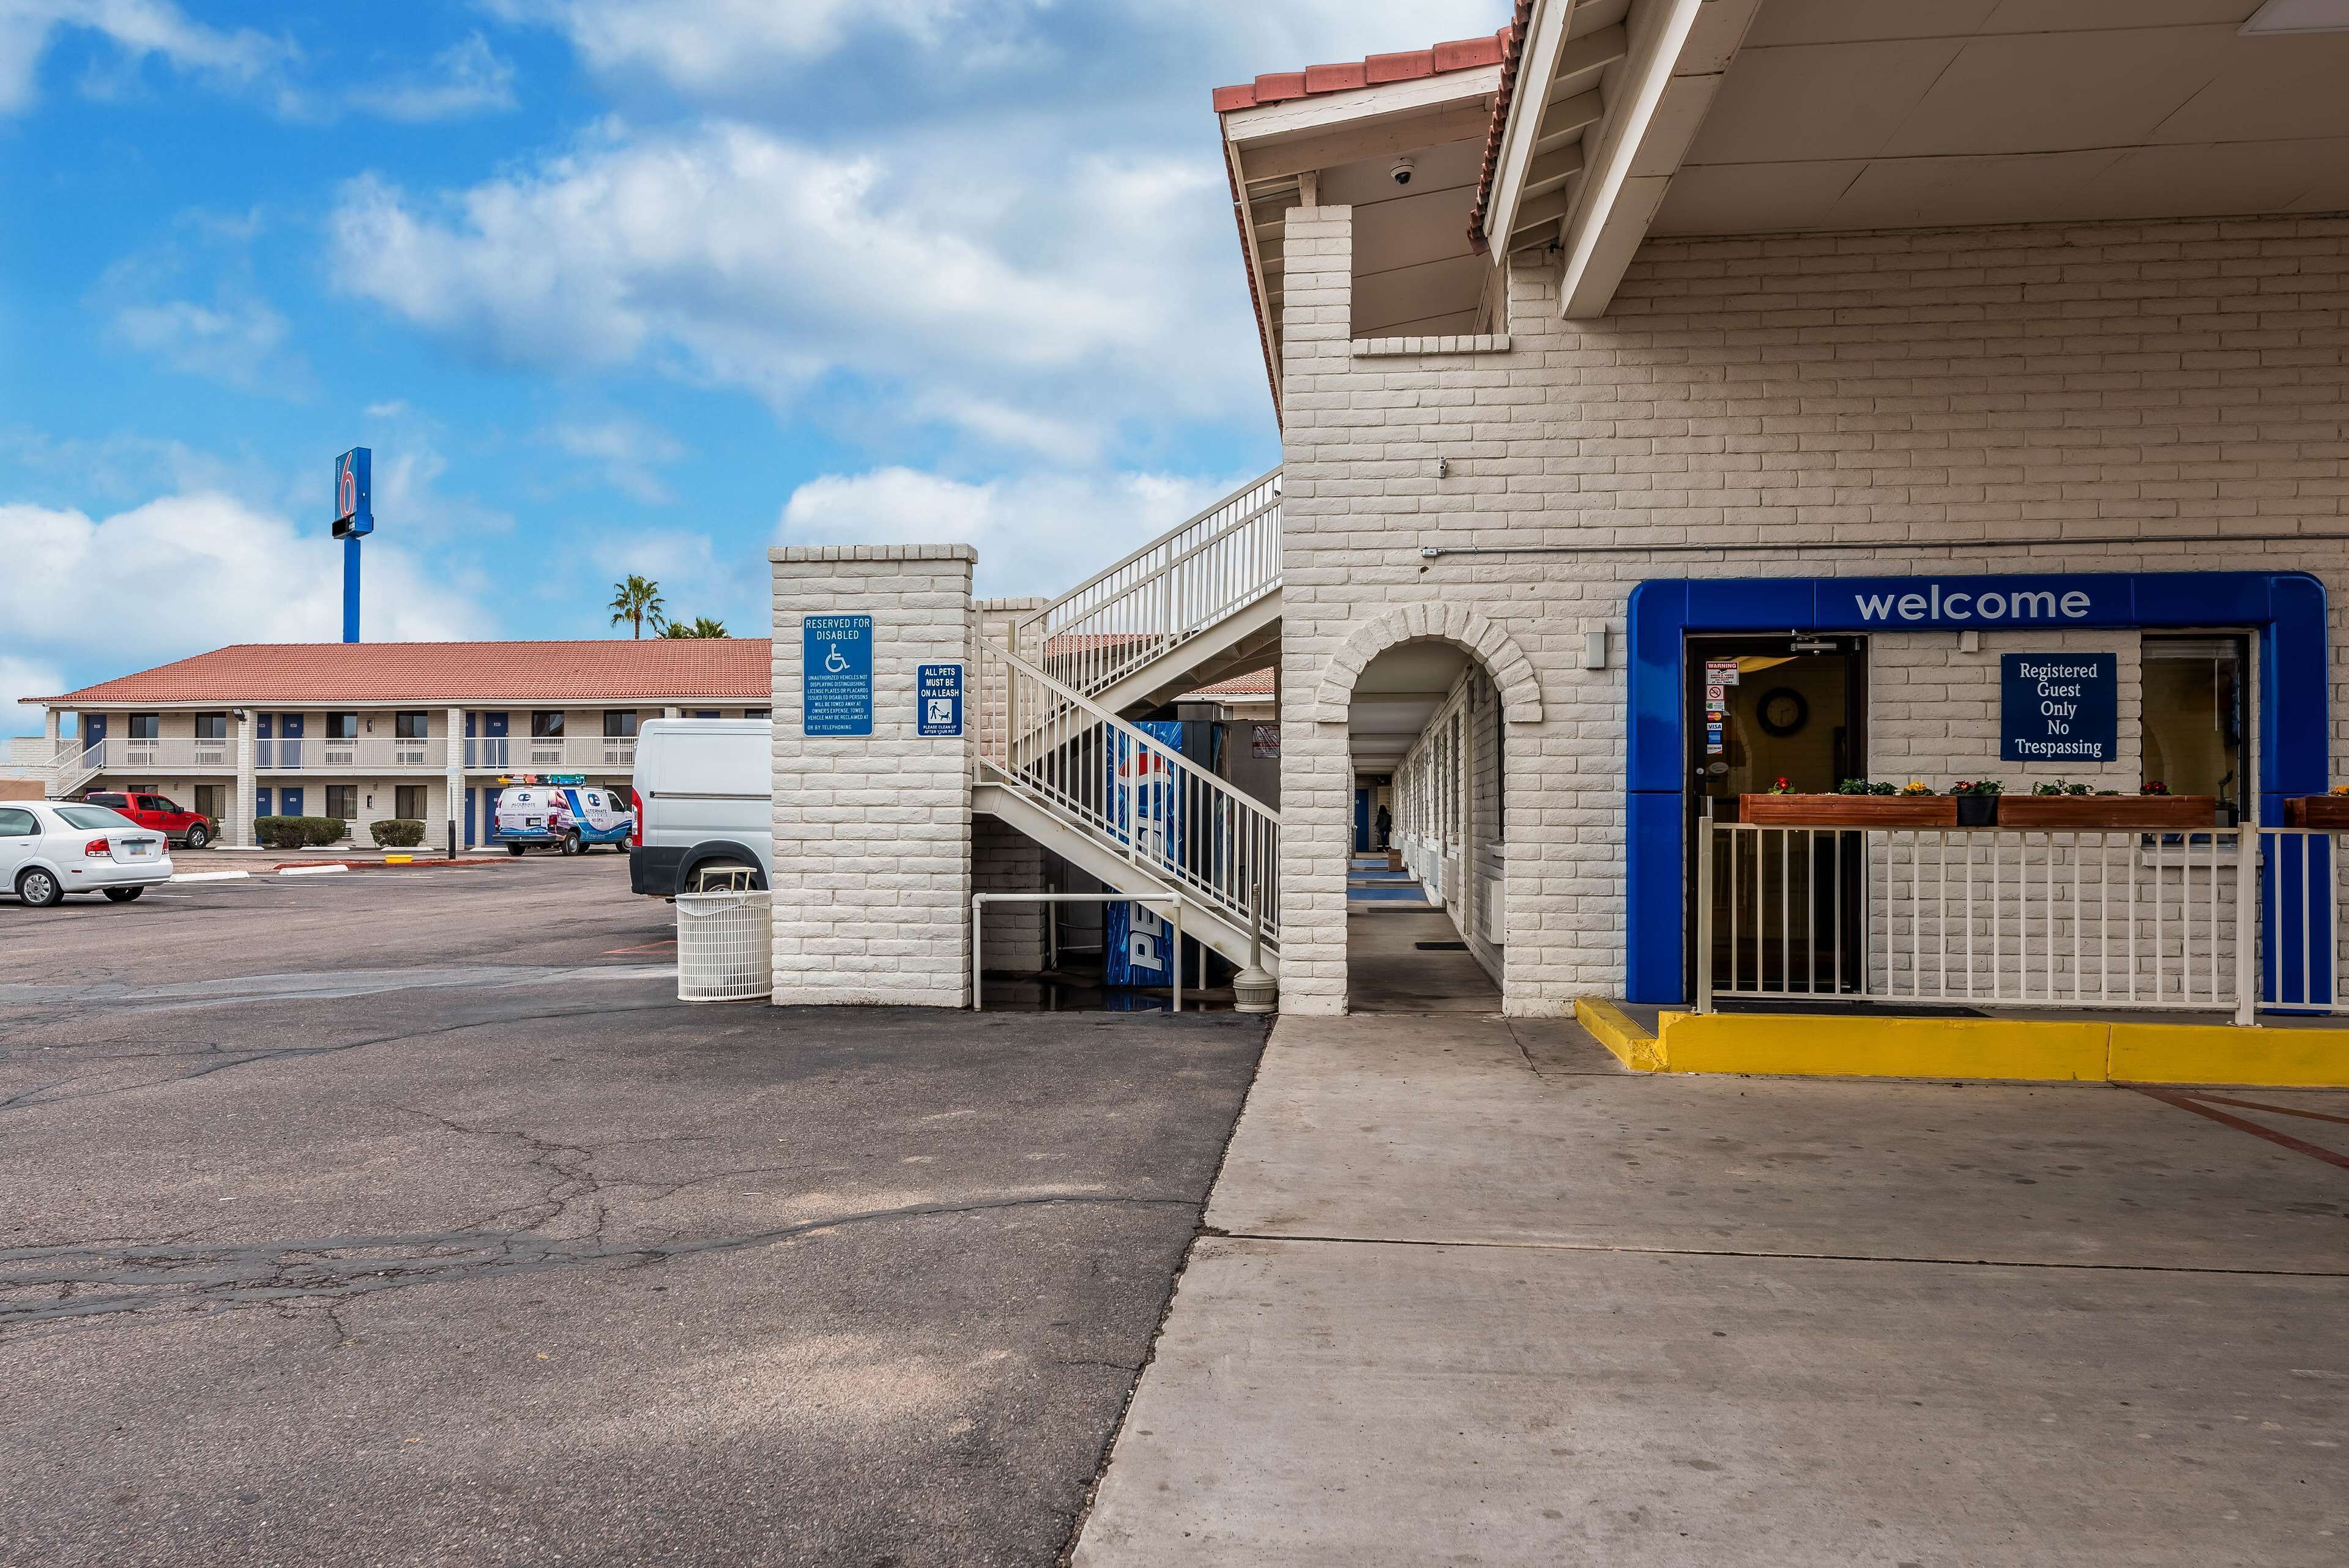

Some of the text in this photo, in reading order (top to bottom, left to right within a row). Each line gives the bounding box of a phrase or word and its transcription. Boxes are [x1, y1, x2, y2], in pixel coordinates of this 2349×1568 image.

[340, 451, 356, 518] 6
[1855, 584, 2091, 620] welcome
[806, 618, 870, 629] RESERVED FOR
[817, 630, 859, 640] DISABLED
[2019, 663, 2098, 682] Registered
[2037, 682, 2081, 697] Guest
[2040, 700, 2077, 719] Only
[2047, 719, 2069, 735] No
[2015, 738, 2102, 758] Trespassing
